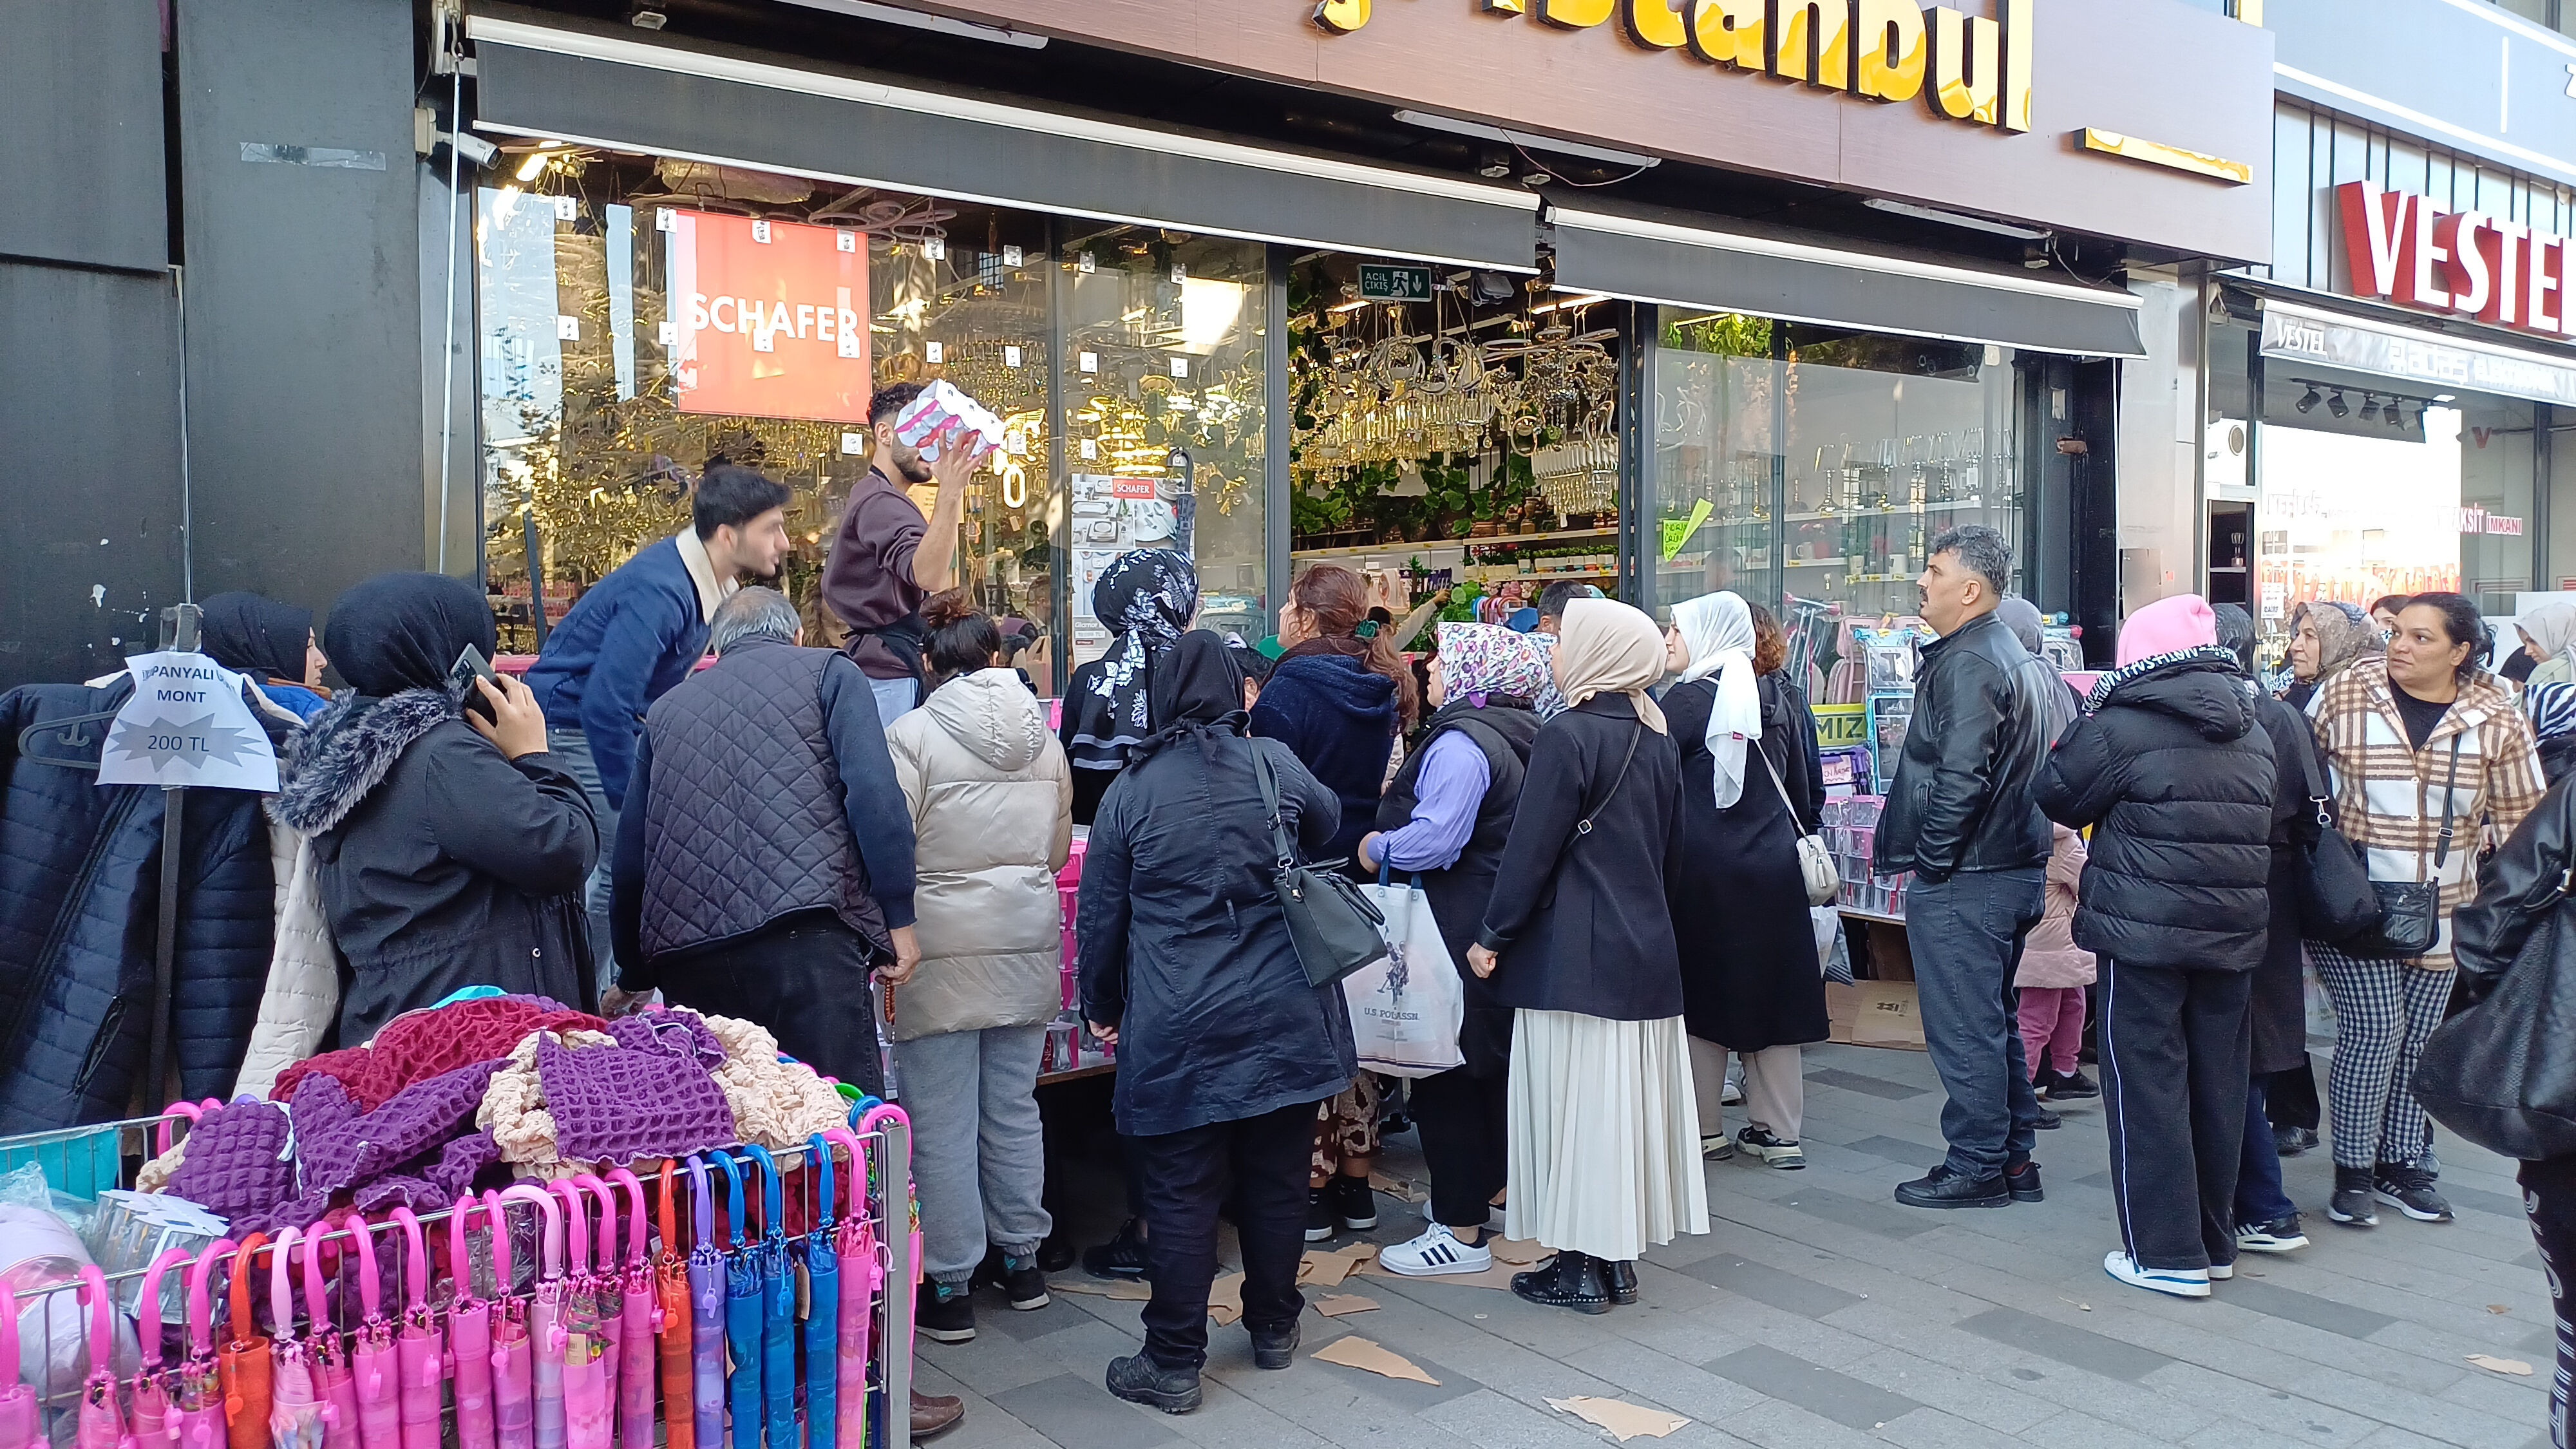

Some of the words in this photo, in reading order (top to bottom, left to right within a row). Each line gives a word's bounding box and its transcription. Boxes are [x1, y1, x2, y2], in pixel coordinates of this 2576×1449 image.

[1484, 0, 2032, 135] anbul
[1365, 272, 1388, 281] ACİL
[1365, 281, 1388, 292] ÇIKIŞ
[687, 292, 859, 343] SCHAFER
[2276, 321, 2327, 355] VESTEL
[1117, 484, 1150, 494] SCHAFER
[2486, 512, 2523, 535] İMKANI
[142, 665, 214, 681] PANYALI
[157, 689, 207, 703] MONT
[147, 735, 182, 750] 200
[189, 737, 210, 752] TL
